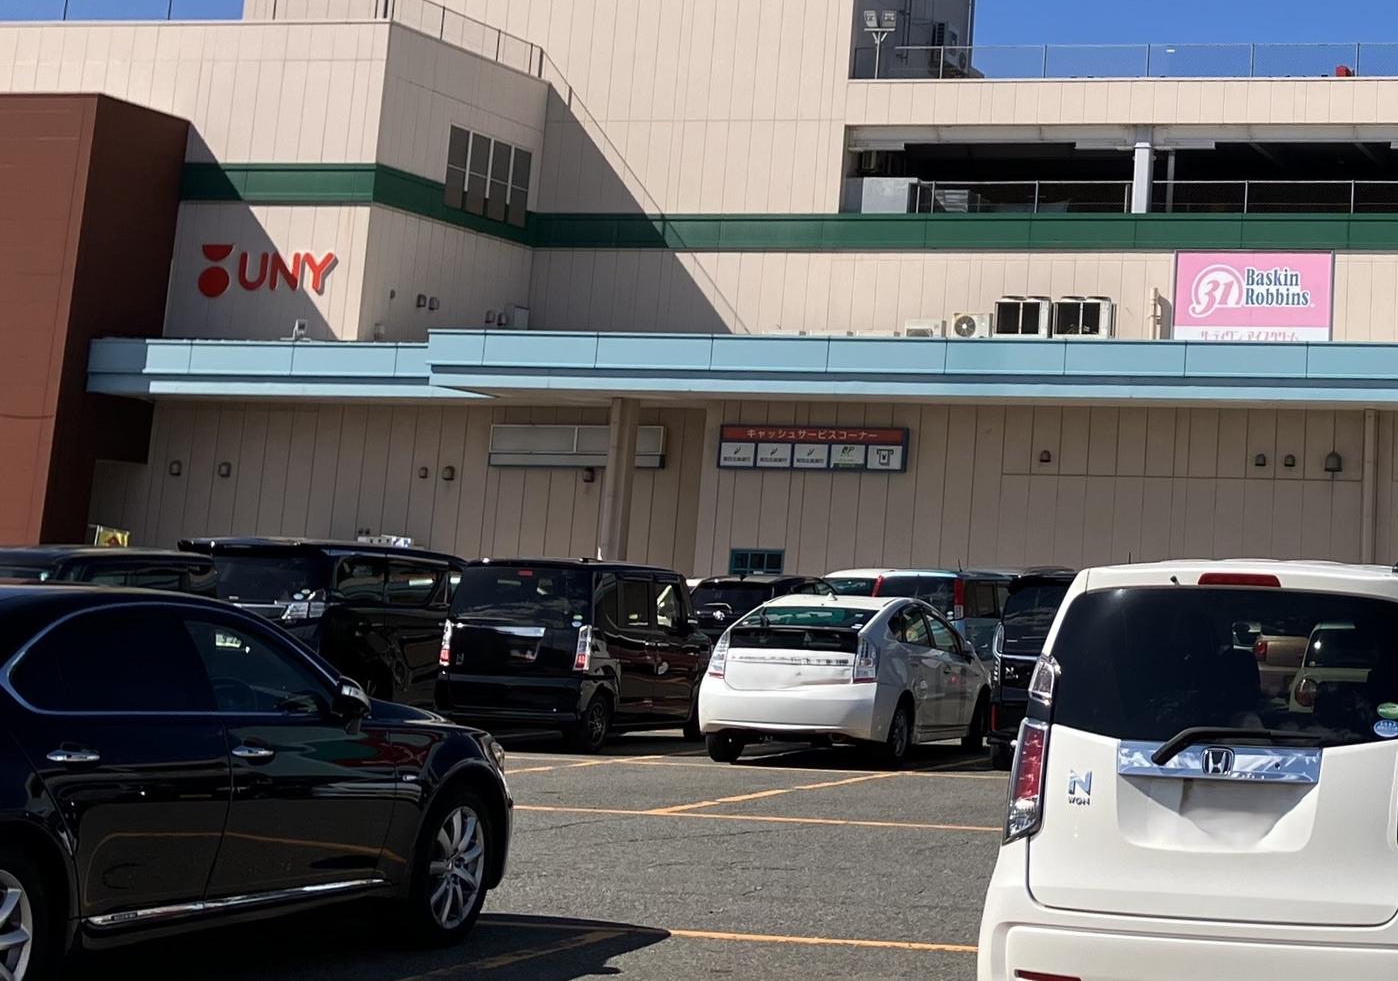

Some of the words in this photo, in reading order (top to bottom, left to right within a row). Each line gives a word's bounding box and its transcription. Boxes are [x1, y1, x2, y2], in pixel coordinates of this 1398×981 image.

[239, 252, 335, 292] UNY
[1246, 268, 1299, 286] Baskin
[1189, 268, 1240, 316] 31
[1245, 288, 1309, 306] Robbins
[747, 429, 878, 440] キャッシュサービスコーナー
